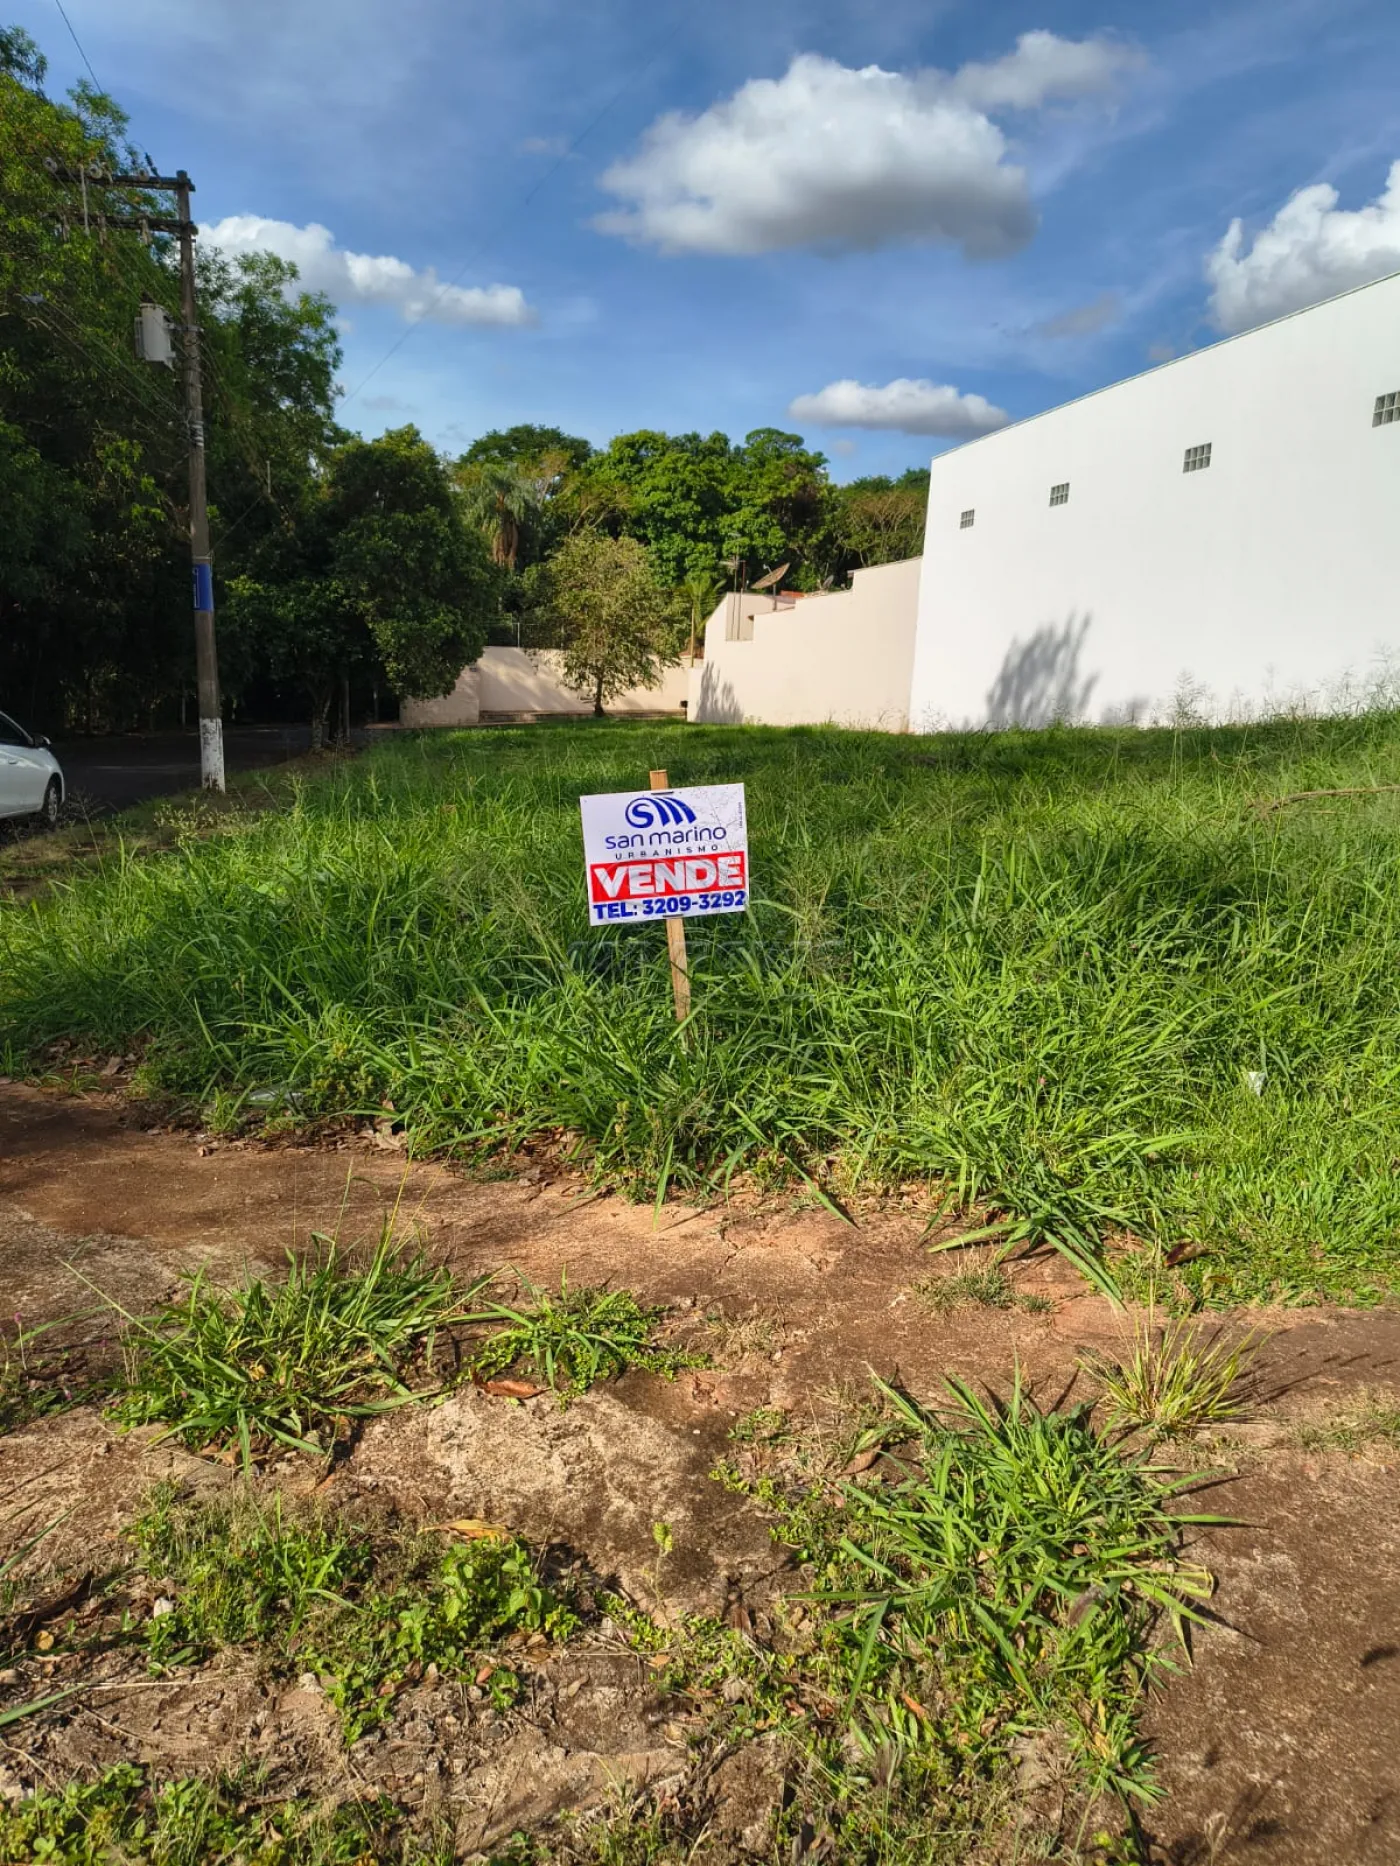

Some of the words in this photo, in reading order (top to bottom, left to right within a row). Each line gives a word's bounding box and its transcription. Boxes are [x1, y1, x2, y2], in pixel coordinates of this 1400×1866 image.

[605, 833, 644, 850] san
[649, 826, 727, 846] marino
[615, 844, 719, 861] URBANISMO
[593, 855, 743, 898] VENDE
[593, 902, 638, 920] TEL:
[642, 890, 747, 915] 3209-3292
